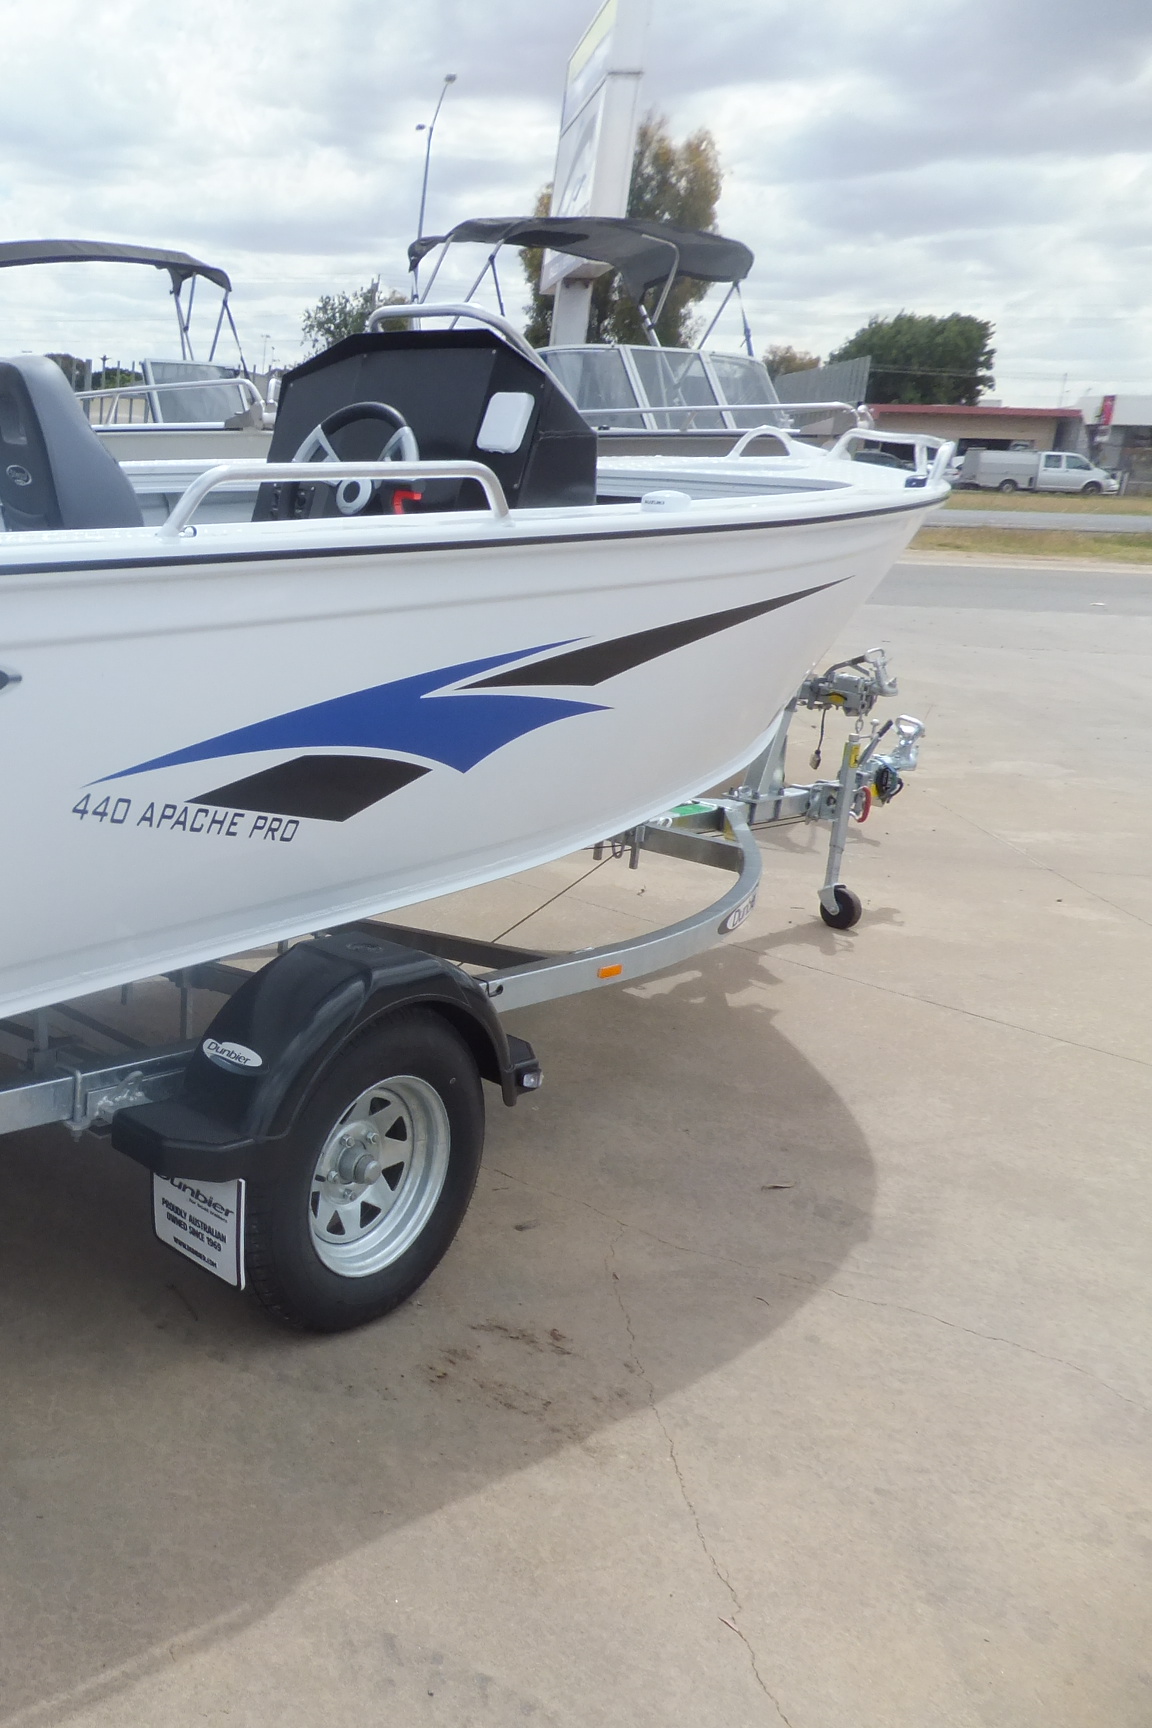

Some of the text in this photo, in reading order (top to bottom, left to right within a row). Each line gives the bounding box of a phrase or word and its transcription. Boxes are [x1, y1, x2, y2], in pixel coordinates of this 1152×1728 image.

[71, 793, 300, 843] 440 APACHE PRO
[207, 1041, 251, 1065] Dunbier
[162, 1197, 227, 1244] PROUDLY AUSTRALIAN
[166, 1211, 188, 1231] OWNED
[189, 1225, 205, 1242] SINCE
